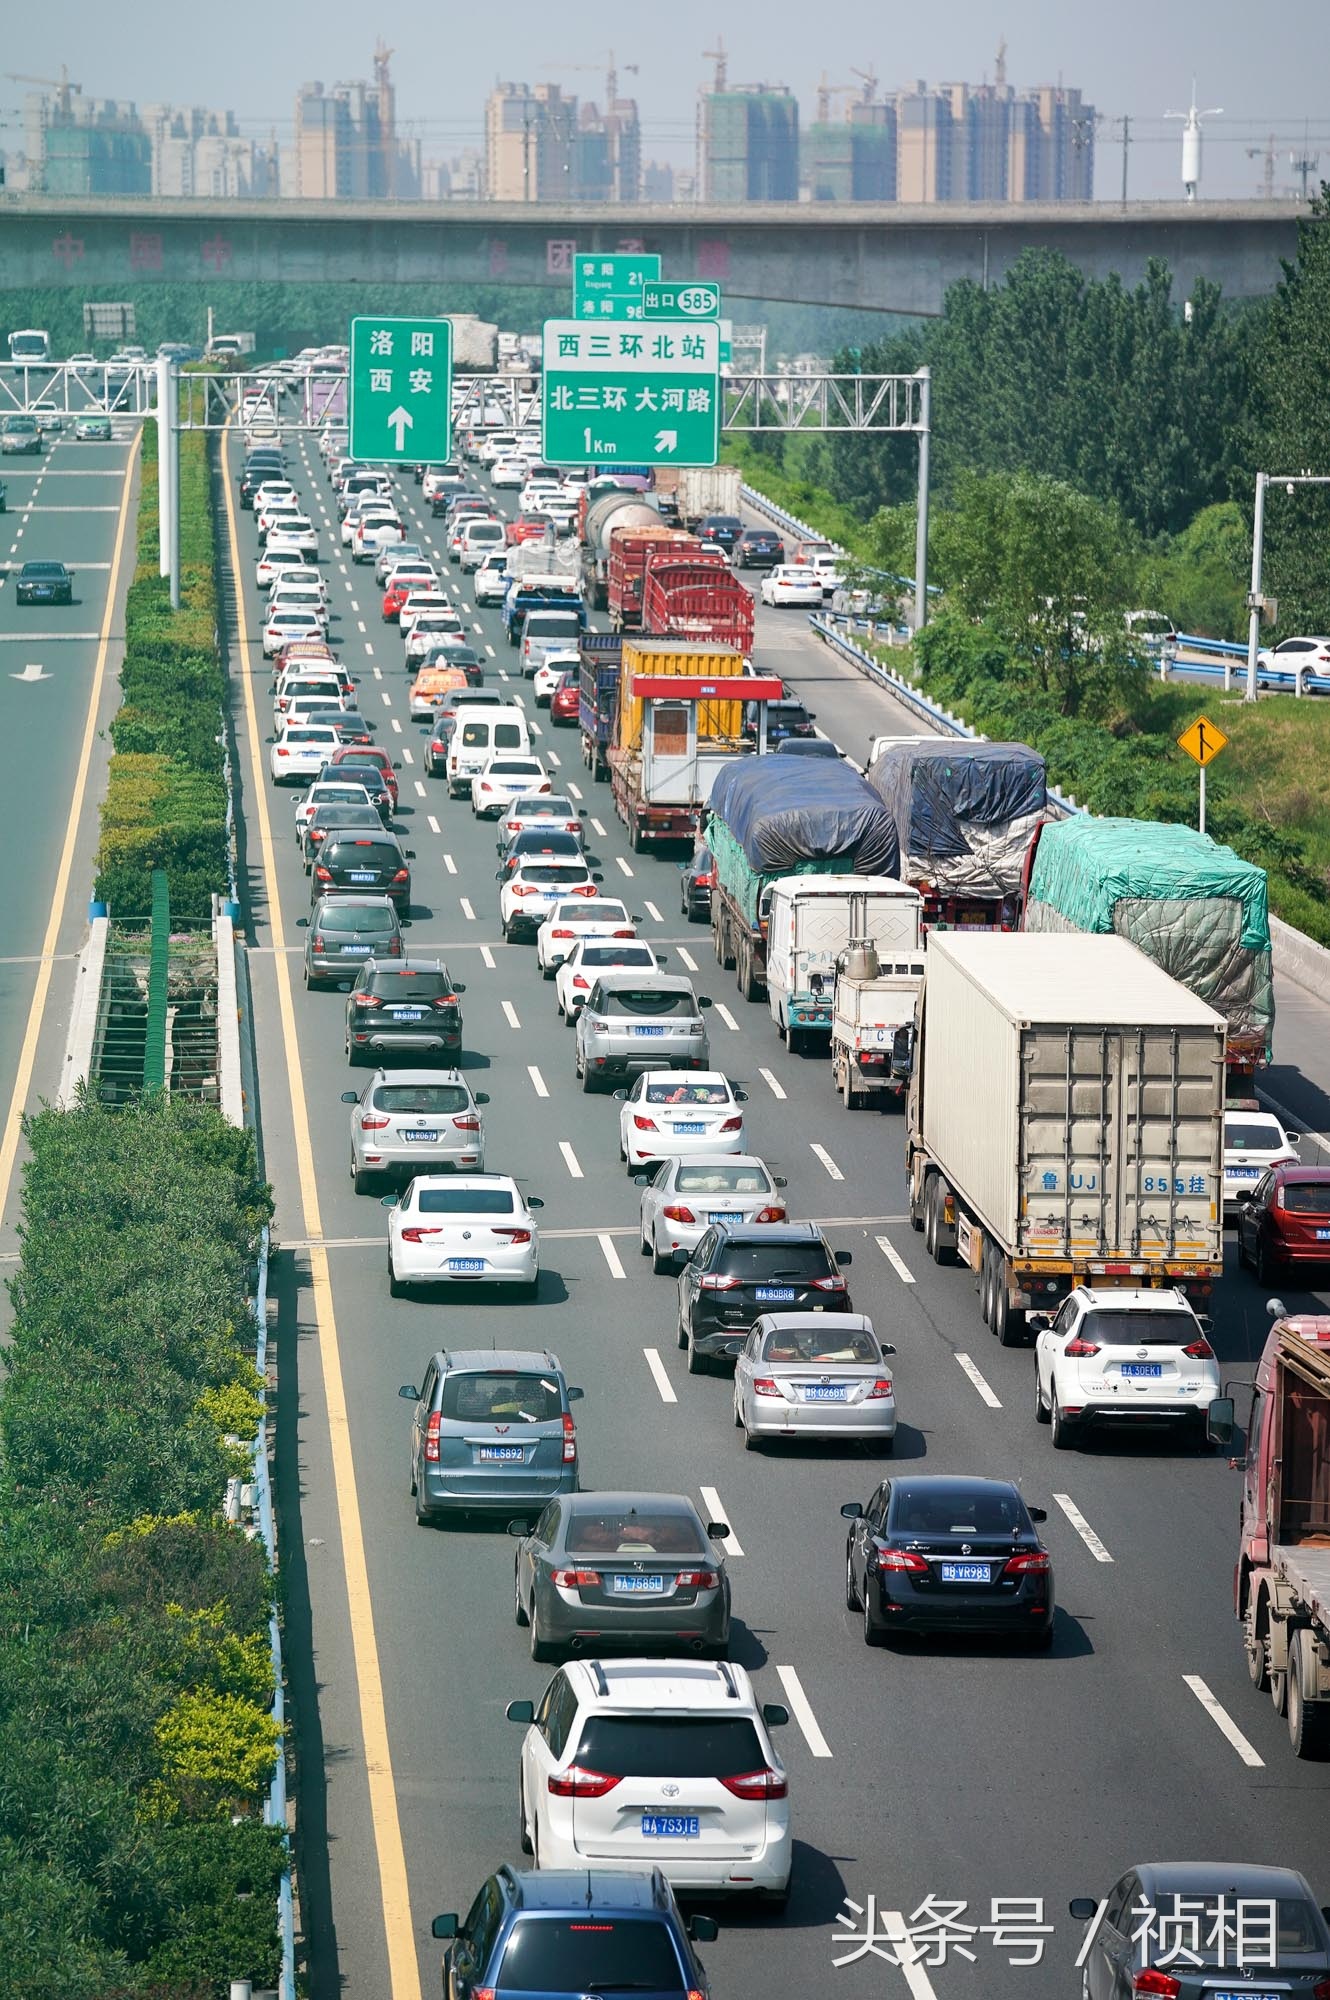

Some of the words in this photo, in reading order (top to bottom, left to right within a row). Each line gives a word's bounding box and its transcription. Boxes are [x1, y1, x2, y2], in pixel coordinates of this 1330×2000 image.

[646, 293, 674, 309] 出口
[683, 293, 712, 309] 585
[370, 330, 433, 357] 洛阳
[558, 334, 706, 360] 西三环北站
[370, 368, 432, 394] 西安
[550, 386, 627, 412] 北三环
[635, 387, 711, 413] 大河路
